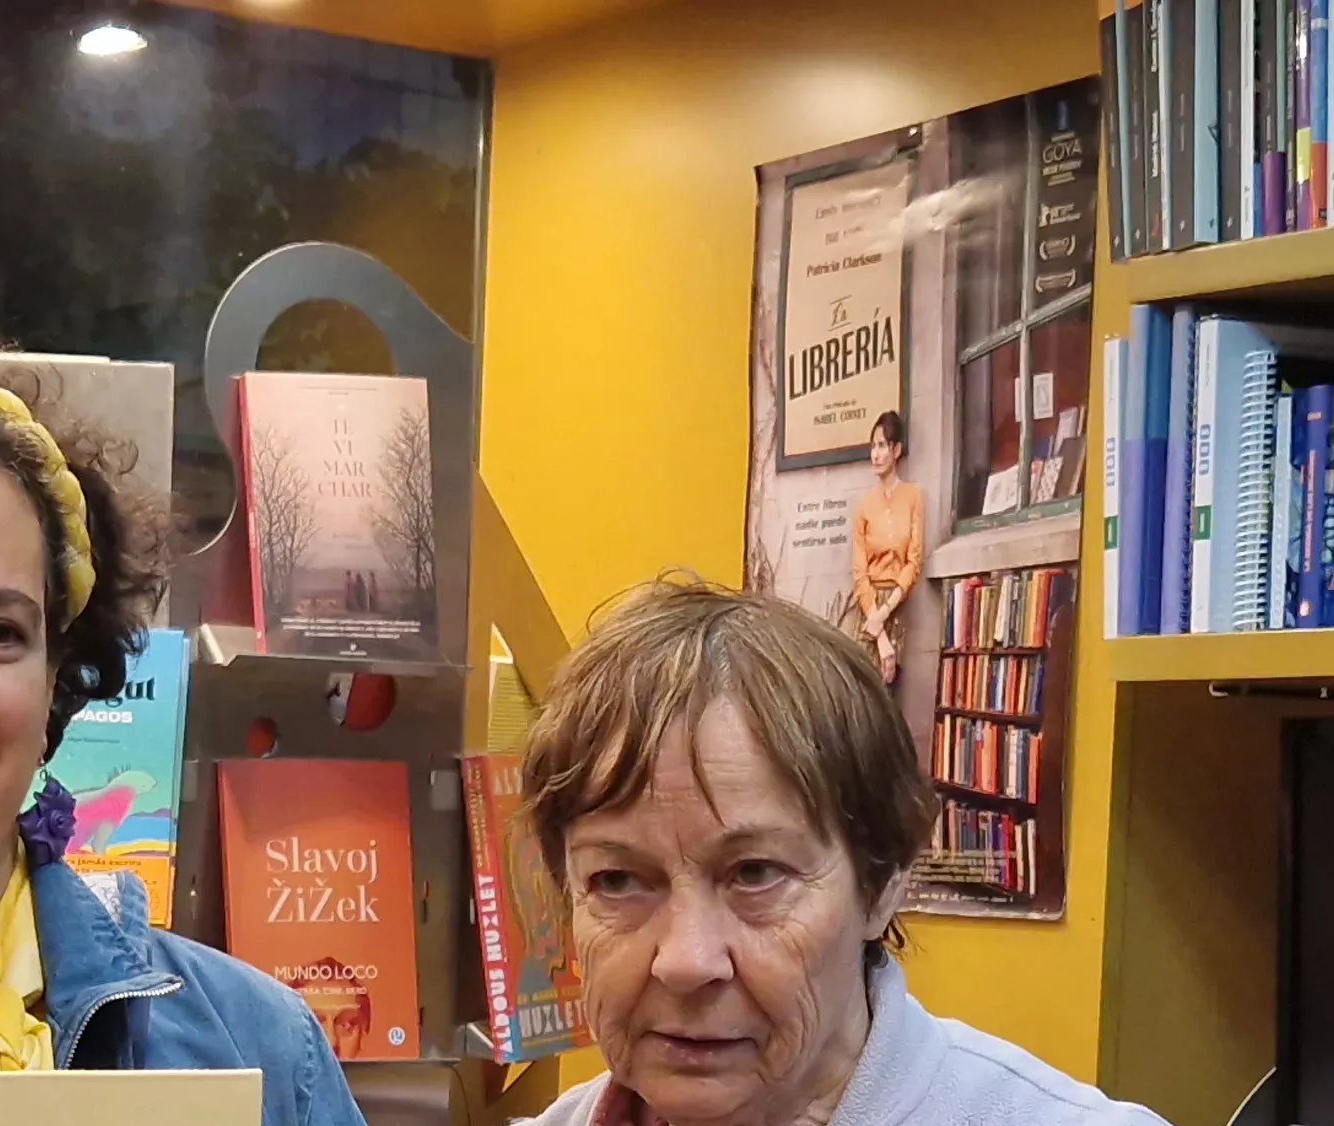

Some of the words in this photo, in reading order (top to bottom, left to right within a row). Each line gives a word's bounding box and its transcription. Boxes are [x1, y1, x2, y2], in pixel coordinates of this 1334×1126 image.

[1042, 138, 1083, 164] GOYA
[806, 262, 840, 278] Patricia
[789, 306, 895, 401] LIBRERÍA
[323, 460, 366, 477] MAR
[317, 481, 373, 499] CHAR
[265, 836, 380, 884] Slavoj
[266, 877, 381, 924] ŽiŽek
[274, 964, 333, 981] MUNDO
[334, 964, 379, 980] LOCO
[489, 969, 514, 1055] ALDOUS
